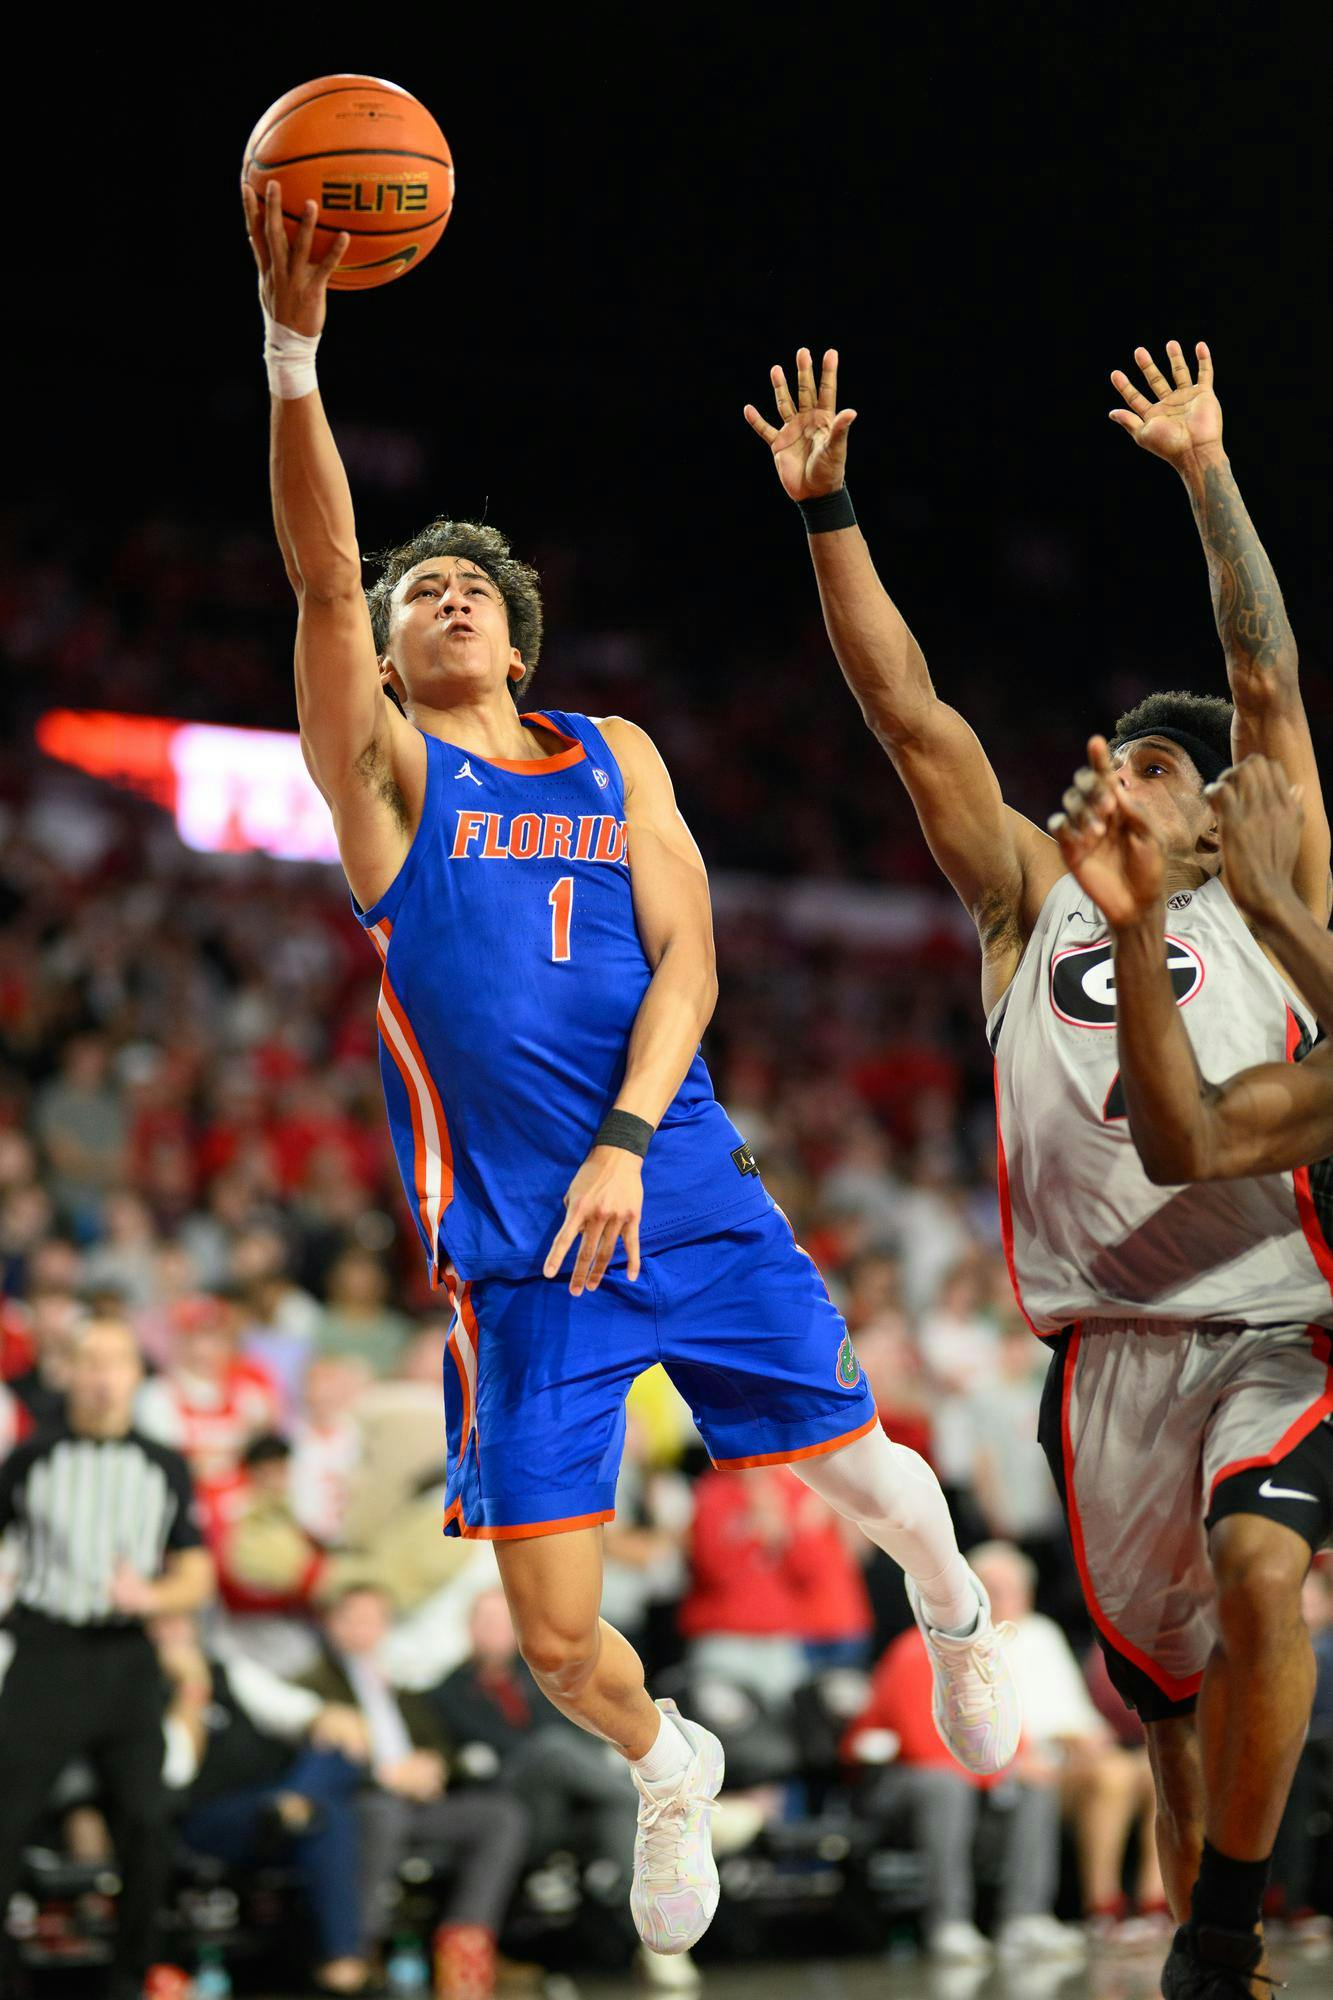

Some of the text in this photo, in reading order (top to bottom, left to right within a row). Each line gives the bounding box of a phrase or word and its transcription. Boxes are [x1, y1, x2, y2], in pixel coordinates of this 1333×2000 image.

[322, 181, 428, 213] ELITE
[1168, 893, 1192, 909] SEC
[548, 876, 574, 963] 1
